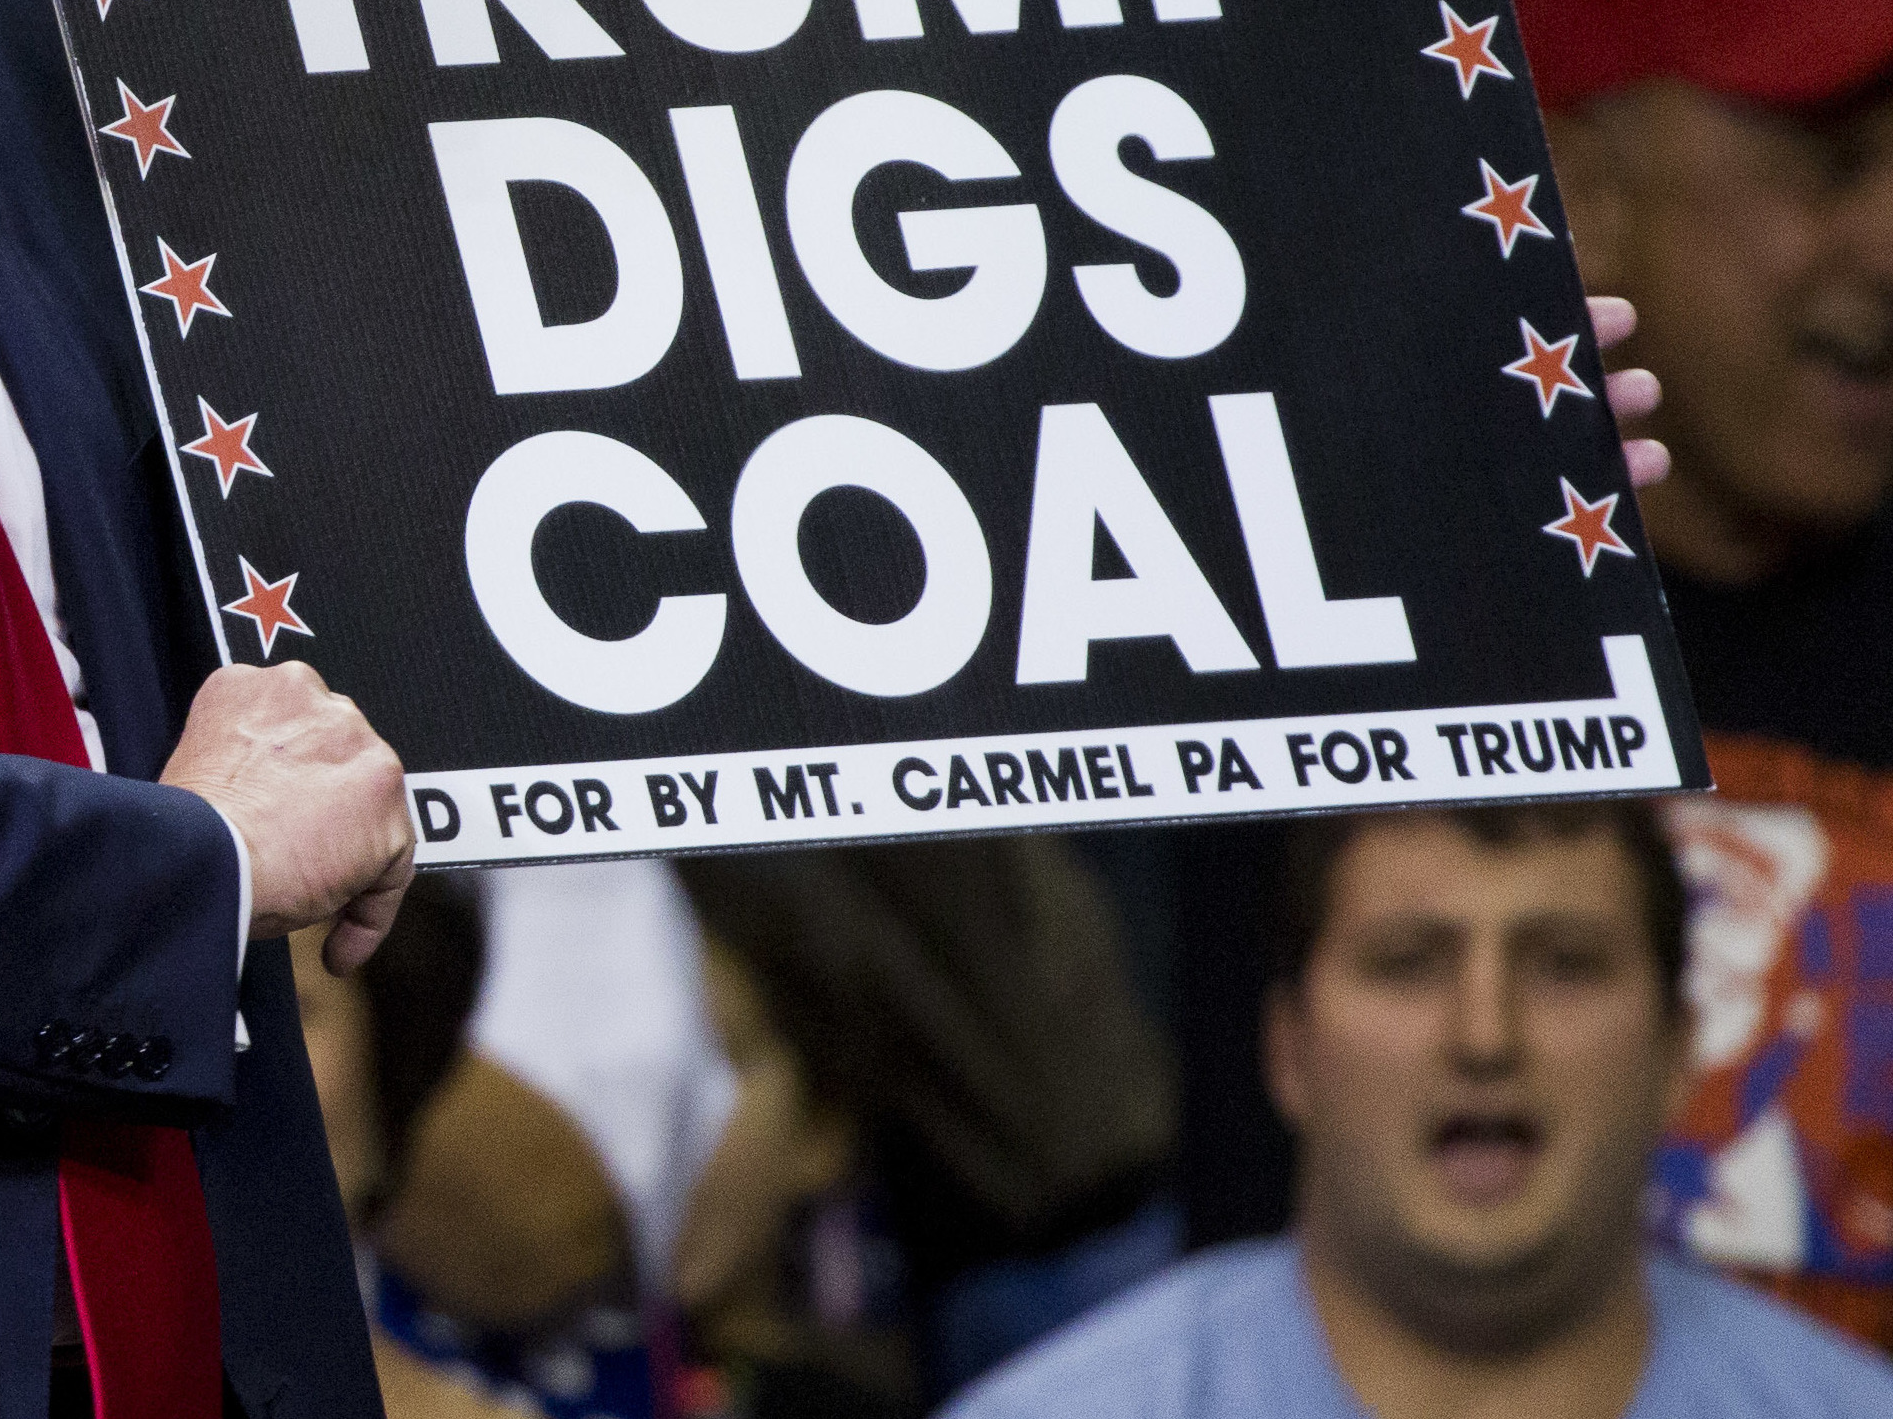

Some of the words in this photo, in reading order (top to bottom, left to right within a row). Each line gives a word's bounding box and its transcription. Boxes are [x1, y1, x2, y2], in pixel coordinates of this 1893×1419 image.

[428, 75, 1246, 395] DIGS
[465, 392, 1416, 714] COAL
[489, 779, 620, 838] FOR
[643, 770, 719, 828] BY
[751, 762, 865, 821] MT.
[892, 745, 1156, 812] CARMEL
[1174, 738, 1265, 794] PA
[1286, 728, 1416, 787] FOR
[1435, 715, 1648, 777] TRUMP
